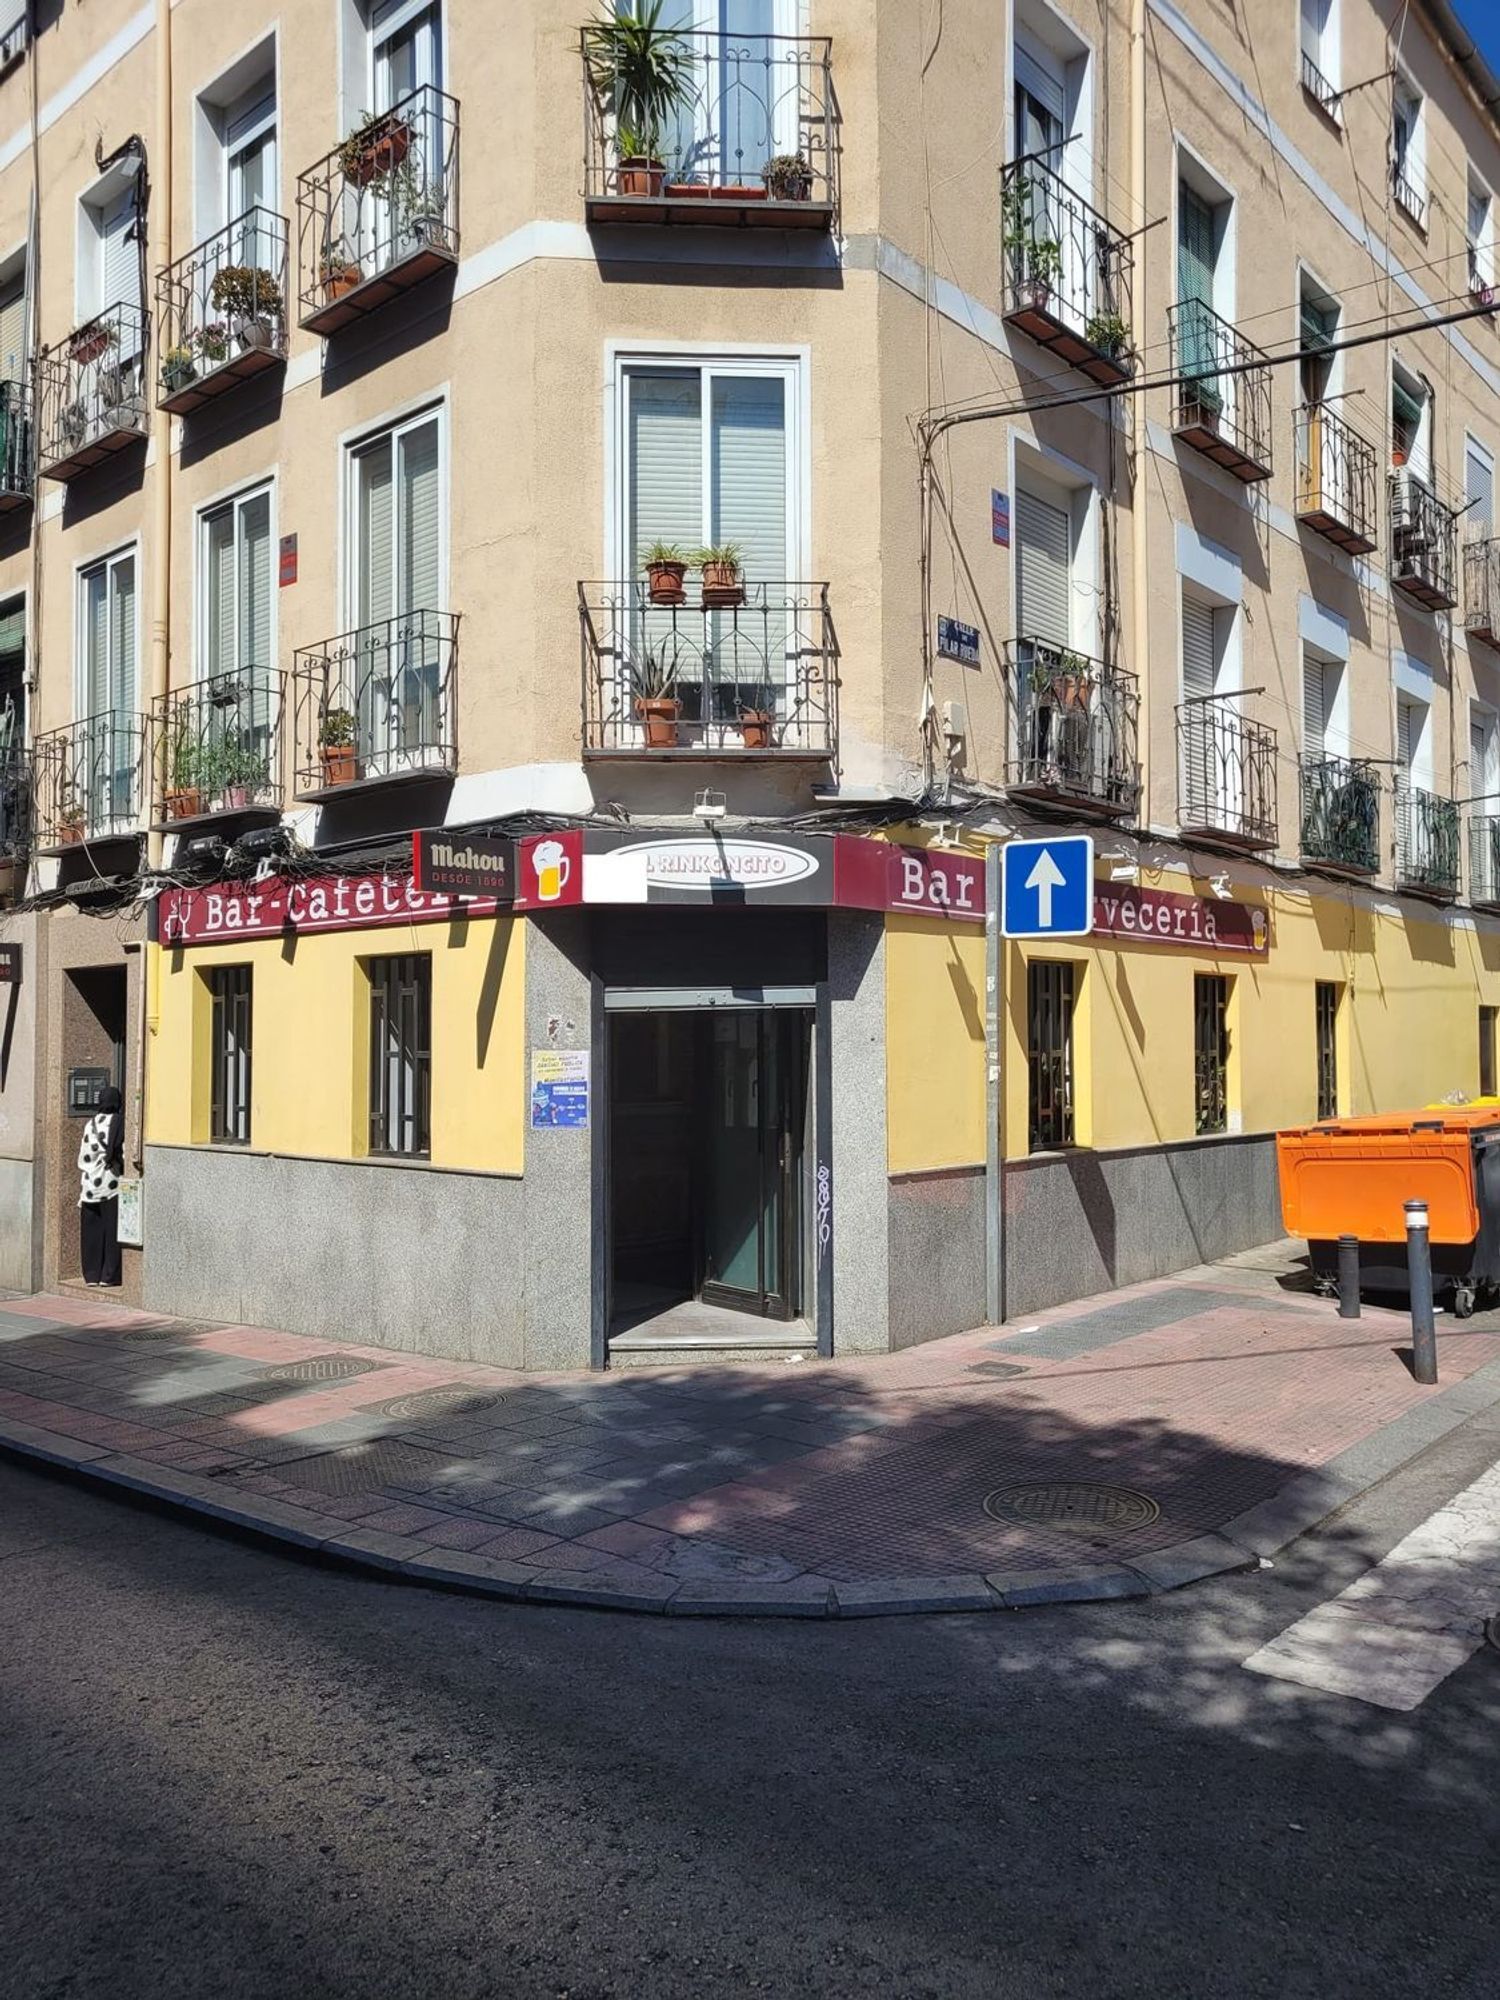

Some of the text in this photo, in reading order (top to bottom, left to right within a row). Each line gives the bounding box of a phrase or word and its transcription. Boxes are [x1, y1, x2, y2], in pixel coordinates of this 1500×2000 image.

[431, 844, 505, 872] Mahou
[658, 854, 786, 874] RINKONCITO
[432, 872, 472, 885] DESDE
[901, 856, 1217, 940] Bar vecería
